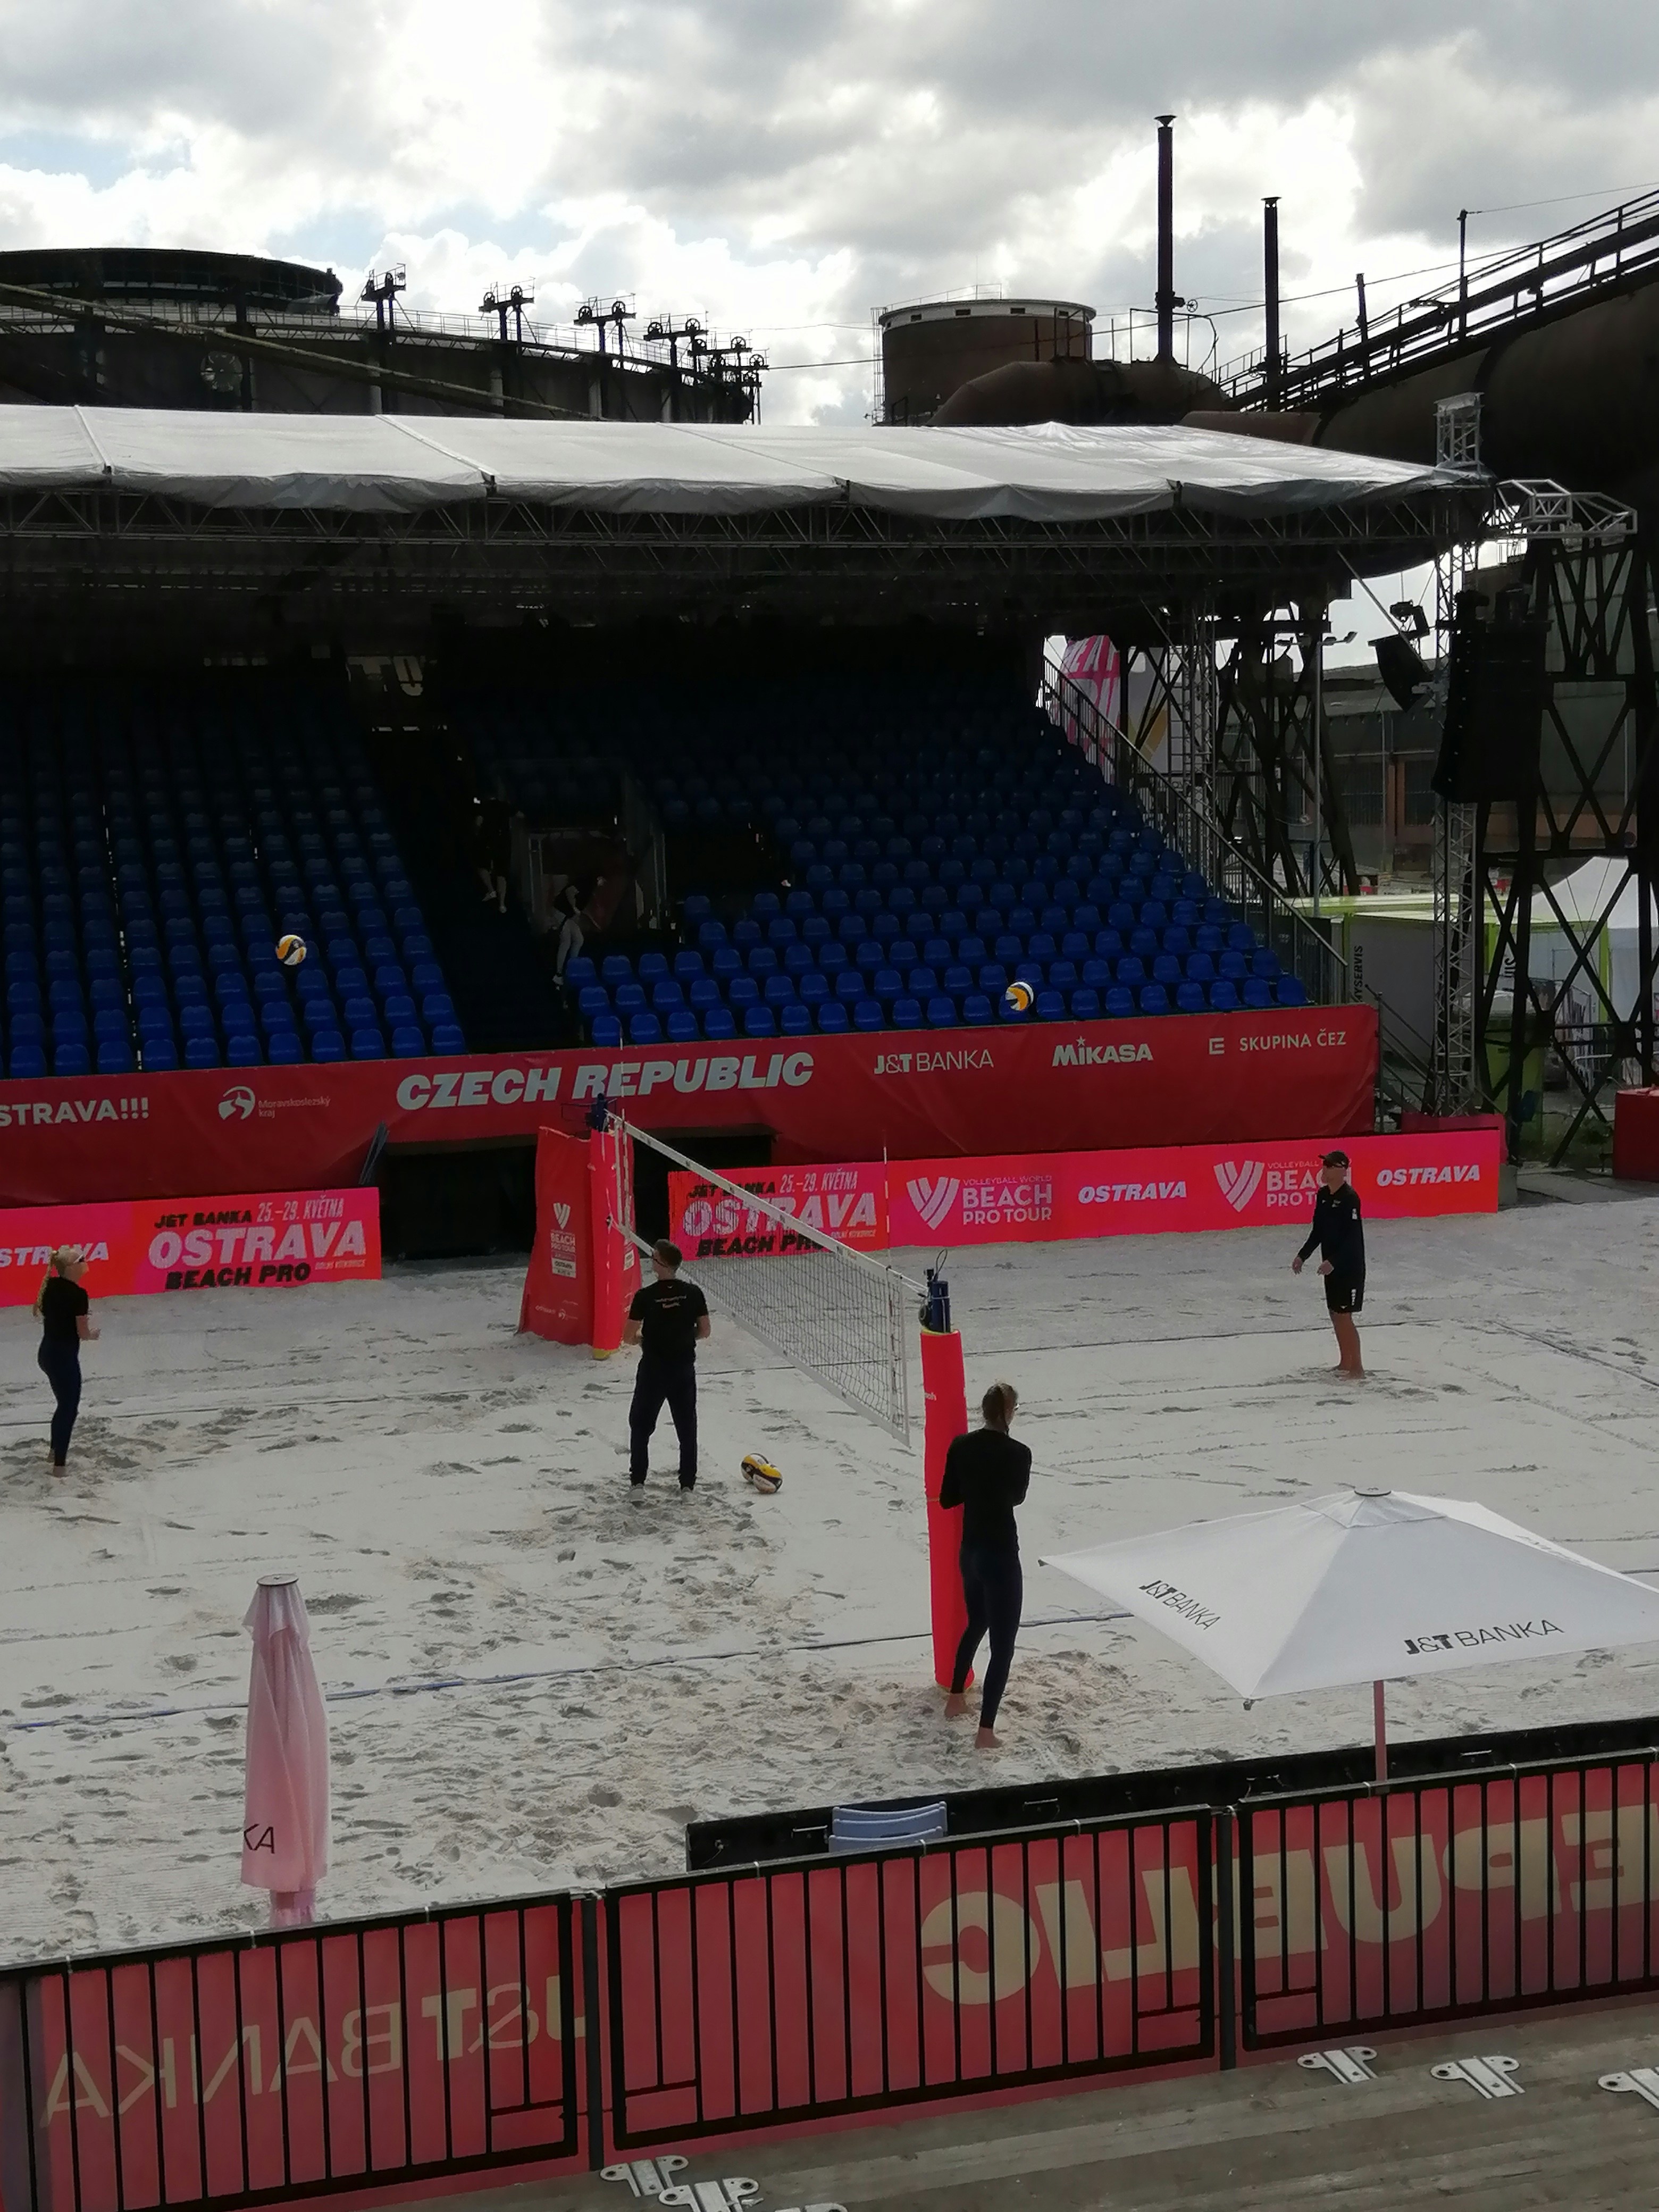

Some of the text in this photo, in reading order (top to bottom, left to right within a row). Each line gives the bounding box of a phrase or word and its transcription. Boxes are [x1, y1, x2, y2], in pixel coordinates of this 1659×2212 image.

[1239, 1033, 1312, 1052] SKUPINA
[1317, 1028, 1346, 1046] ČEZ
[874, 1049, 994, 1075] J&T BANKA
[397, 1052, 815, 1110] CZECH REPUBLIC
[258, 1109, 275, 1119] kraj
[1268, 1160, 1320, 1169] VOLLEYBALL
[1376, 1164, 1480, 1187] OSTRAVA
[821, 1168, 858, 1191] KVĚTNA
[962, 1175, 1052, 1186] VOLLEYBALL WORLD
[962, 1184, 1052, 1209] BEACH
[1077, 1181, 1187, 1204] OSTRAVA
[1267, 1191, 1303, 1208] PRO
[193, 1210, 253, 1225] BANKA
[303, 1195, 345, 1220] KVĚTNA
[683, 1192, 877, 1237] OSTRAVA
[963, 1206, 1052, 1225] PRO TOUR
[148, 1220, 366, 1269] OSTRAVA
[550, 1233, 576, 1247] BEACH
[697, 1235, 774, 1257] BEACH
[165, 1266, 253, 1289] BEACH
[258, 1262, 311, 1284] PRO
[1138, 1580, 1221, 1630] J&T BANKA
[1404, 1619, 1565, 1655] J&T BANKA
